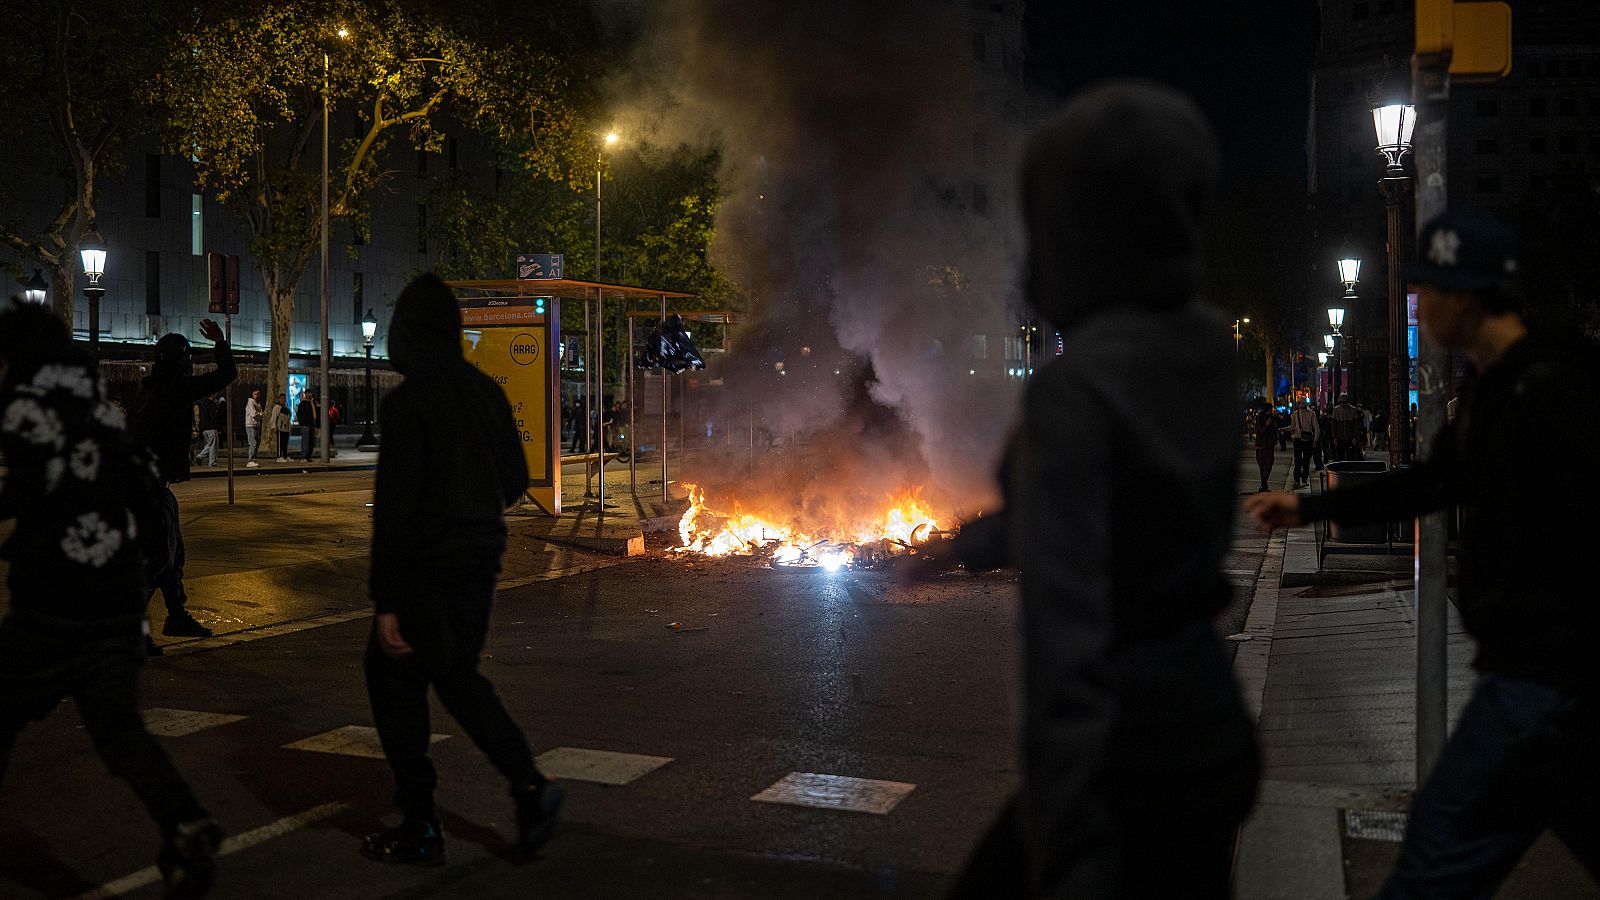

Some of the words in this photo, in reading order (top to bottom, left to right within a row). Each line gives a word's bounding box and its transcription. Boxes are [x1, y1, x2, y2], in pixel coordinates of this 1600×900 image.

[549, 268, 560, 277] A1
[463, 311, 536, 322] www.barcelona.cat
[513, 344, 536, 355] ARAG
